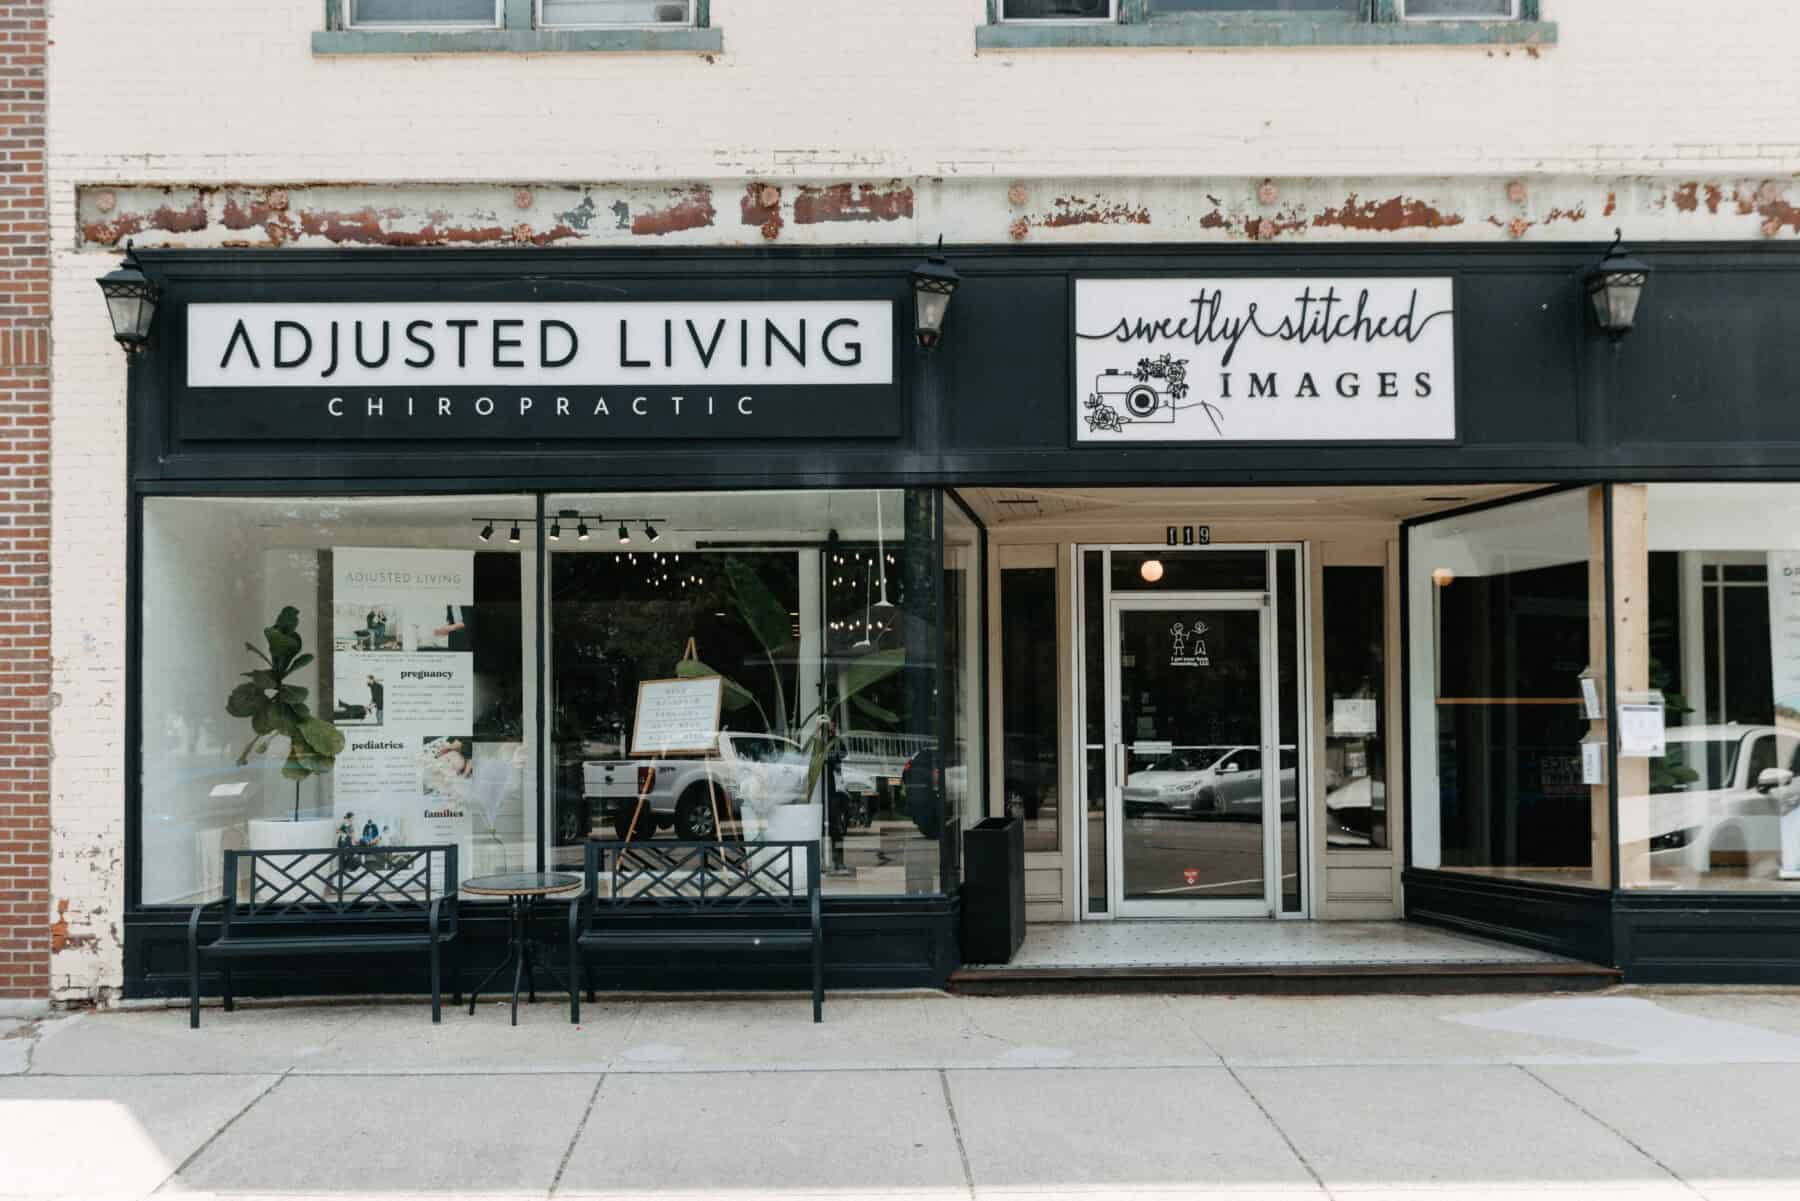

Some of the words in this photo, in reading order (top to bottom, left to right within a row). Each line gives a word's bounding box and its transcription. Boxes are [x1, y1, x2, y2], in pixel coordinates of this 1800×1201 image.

[1077, 287, 1263, 367] sweetly
[1277, 285, 1453, 344] stitched
[220, 320, 578, 378] ADJUSTED
[620, 318, 861, 368] LIVING
[1219, 371, 1433, 398] IMAGES
[327, 395, 755, 417] CHIROPRACTIC
[1168, 527, 1209, 545] 119
[416, 574, 462, 585] LIVING
[400, 669, 454, 680] pregnancy
[351, 740, 404, 751] pediatrics
